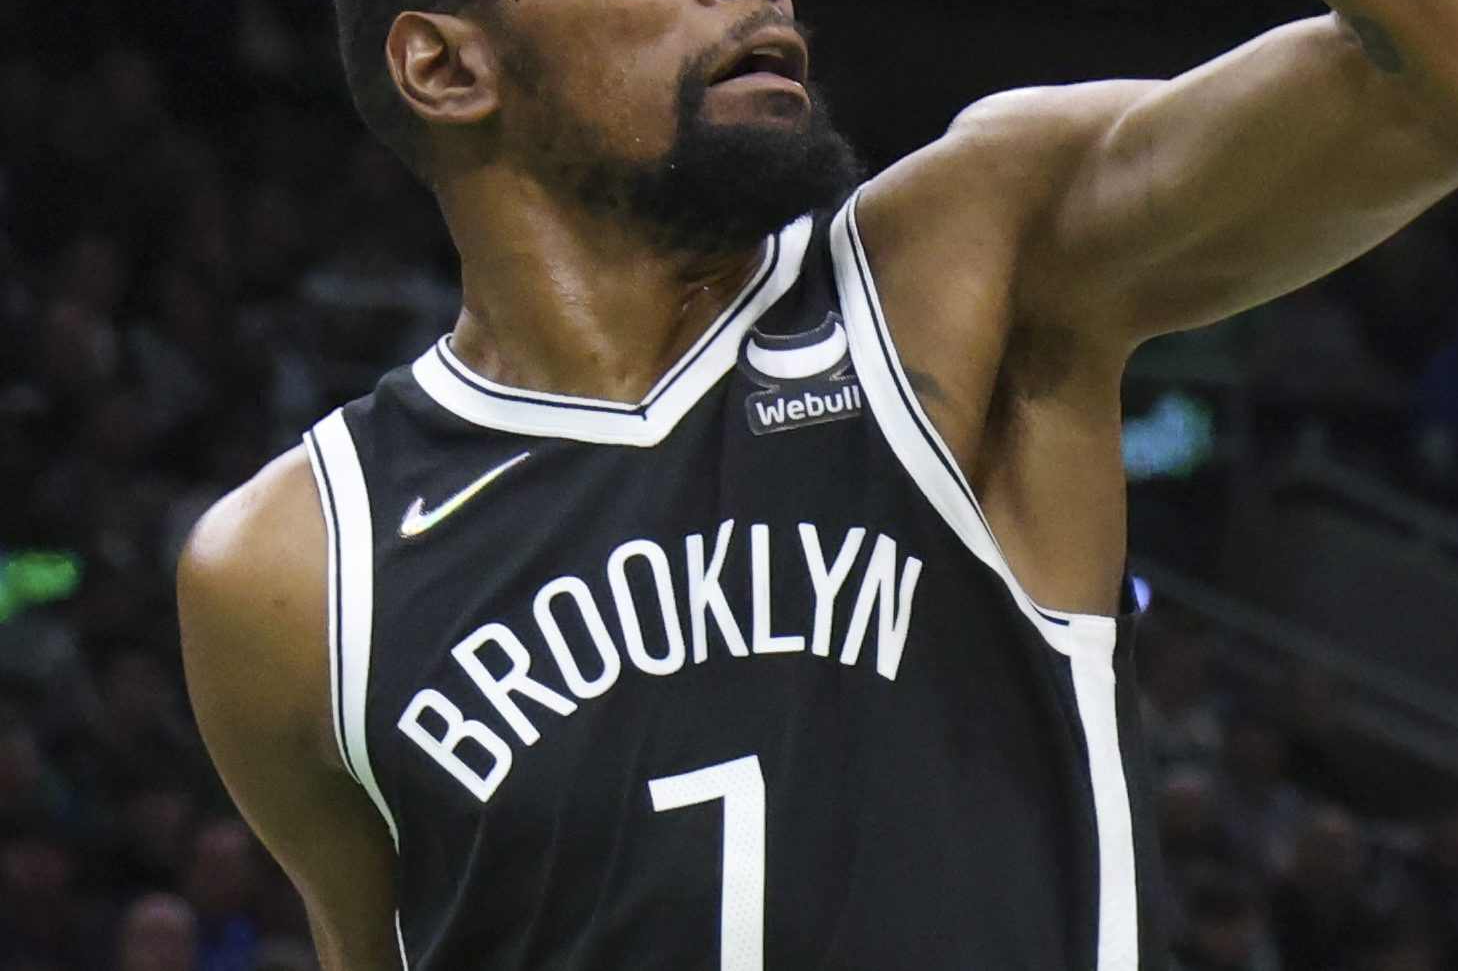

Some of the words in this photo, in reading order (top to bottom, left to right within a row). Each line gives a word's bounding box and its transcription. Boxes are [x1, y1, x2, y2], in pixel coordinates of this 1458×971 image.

[755, 383, 862, 426] Webull
[397, 518, 923, 803] BROOKLYN
[648, 754, 766, 971] 7
